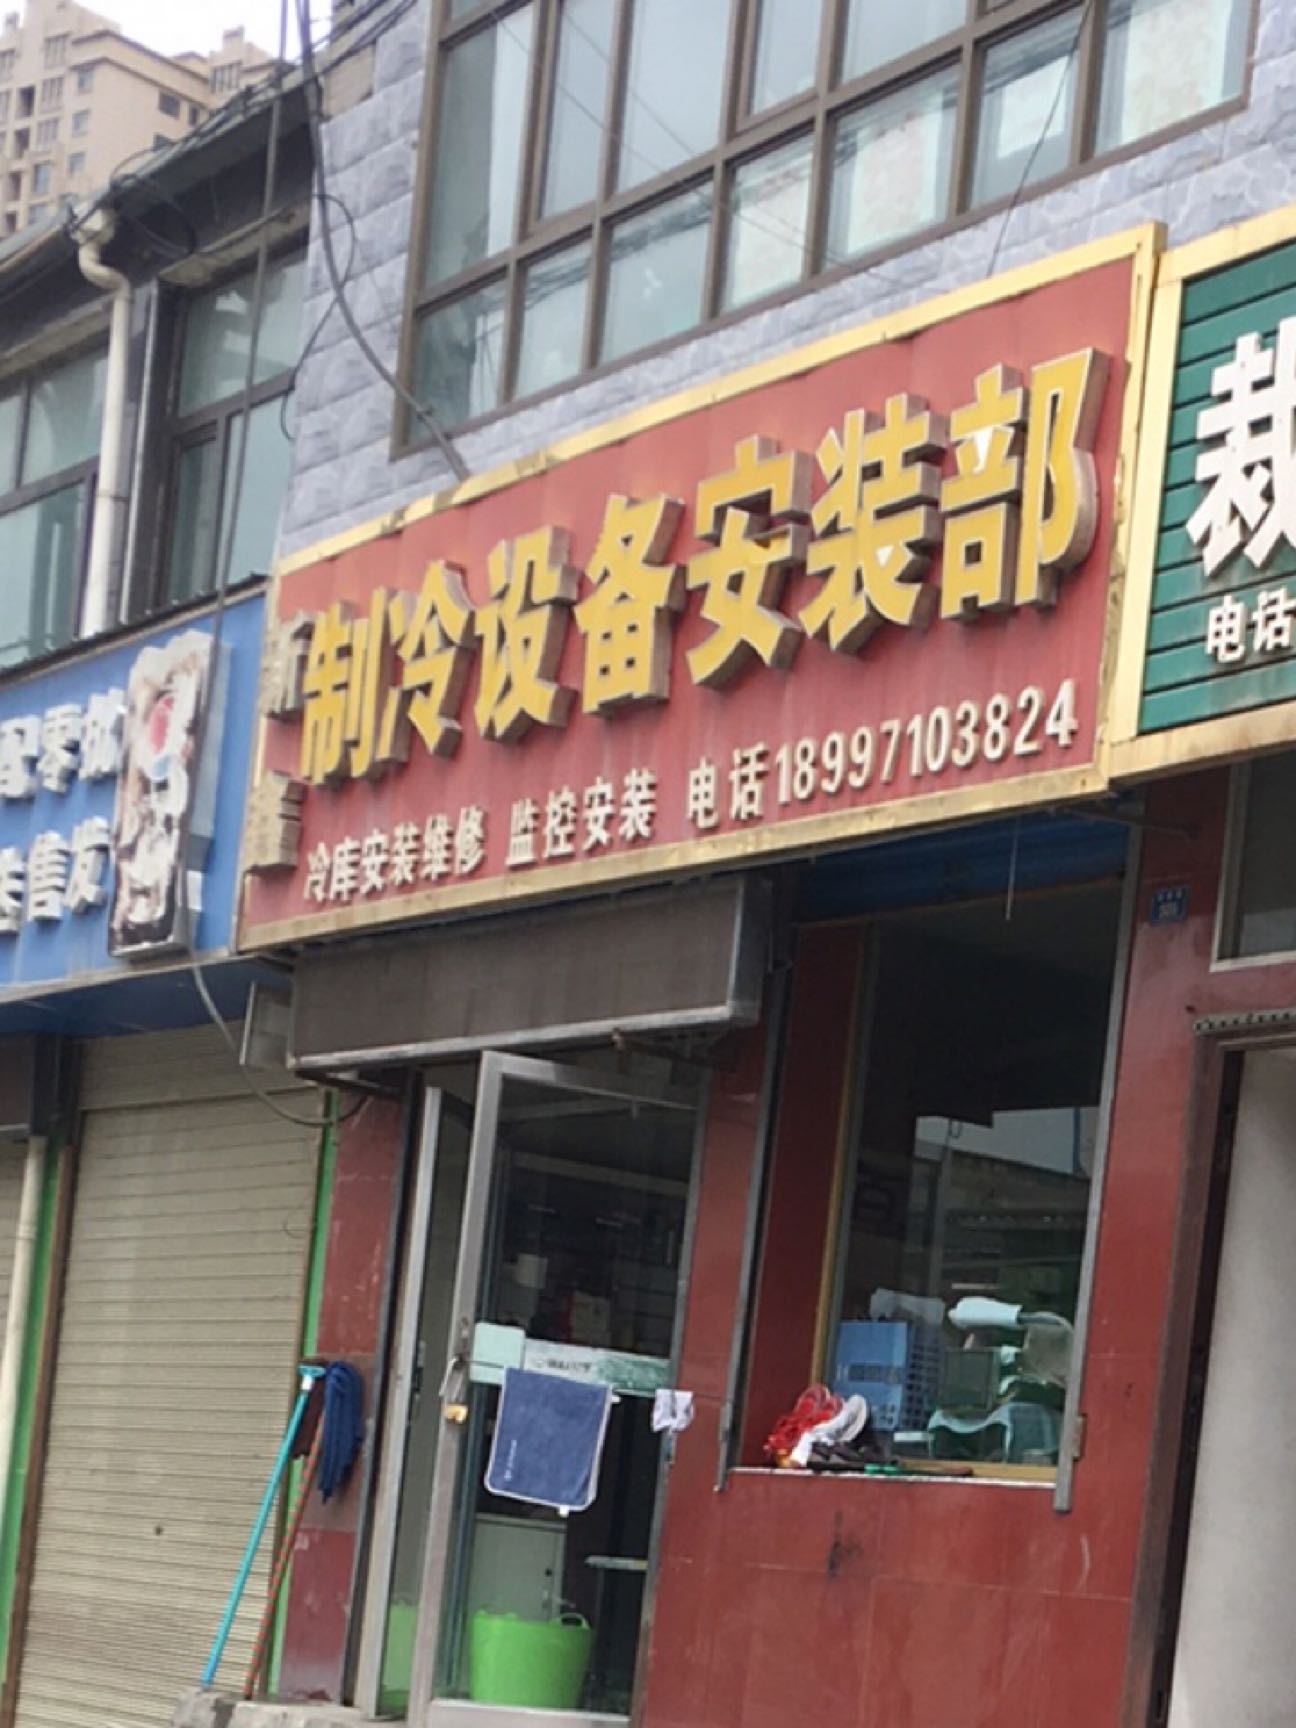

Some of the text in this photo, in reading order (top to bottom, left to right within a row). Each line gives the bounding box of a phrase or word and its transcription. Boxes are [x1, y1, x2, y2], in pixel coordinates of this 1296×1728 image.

[303, 347, 1108, 788] 制冷设备安装部
[303, 804, 484, 902] 冷库安装维修
[505, 767, 658, 866] 监控安装
